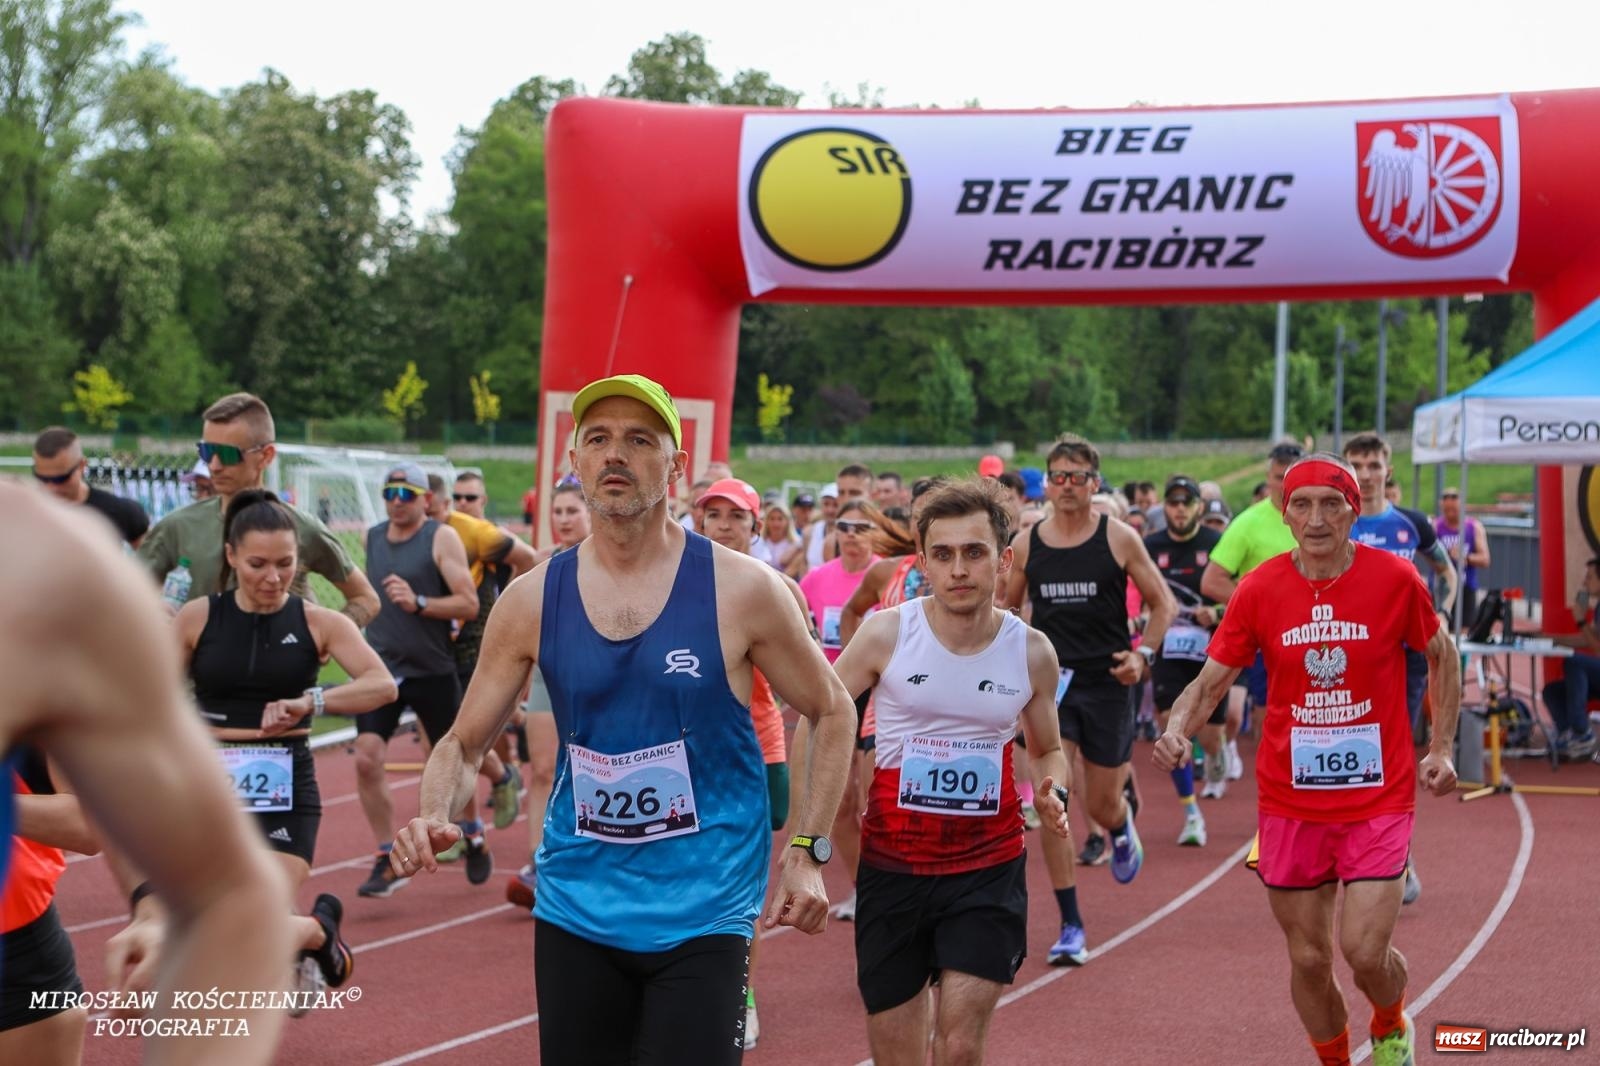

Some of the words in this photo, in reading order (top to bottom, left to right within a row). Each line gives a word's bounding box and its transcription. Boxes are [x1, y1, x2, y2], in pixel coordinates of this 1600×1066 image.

[1055, 126, 1192, 155] BIEG
[829, 146, 906, 174] SIR
[955, 179, 1071, 214] BEZ
[1080, 174, 1295, 213] GRANIC
[983, 226, 1266, 270] RACIBÓRZ
[1500, 415, 1600, 442] Person
[1040, 582, 1097, 598] RUNNING
[1312, 604, 1333, 621] OD
[1282, 621, 1369, 646] URODZENIA
[907, 674, 929, 685] 4F
[1305, 690, 1352, 707] DUMNI
[1296, 699, 1372, 725] POCHODZENIA
[1346, 726, 1373, 734] GRANIC
[911, 736, 928, 745] XVII
[930, 739, 950, 748] BIEG
[952, 741, 968, 749] BEZ
[969, 742, 998, 750] GRANIC
[611, 756, 632, 767] BEZ
[634, 745, 675, 762] GRANIC
[1315, 752, 1359, 773] 168
[927, 768, 978, 795] 190
[595, 787, 660, 819] 226
